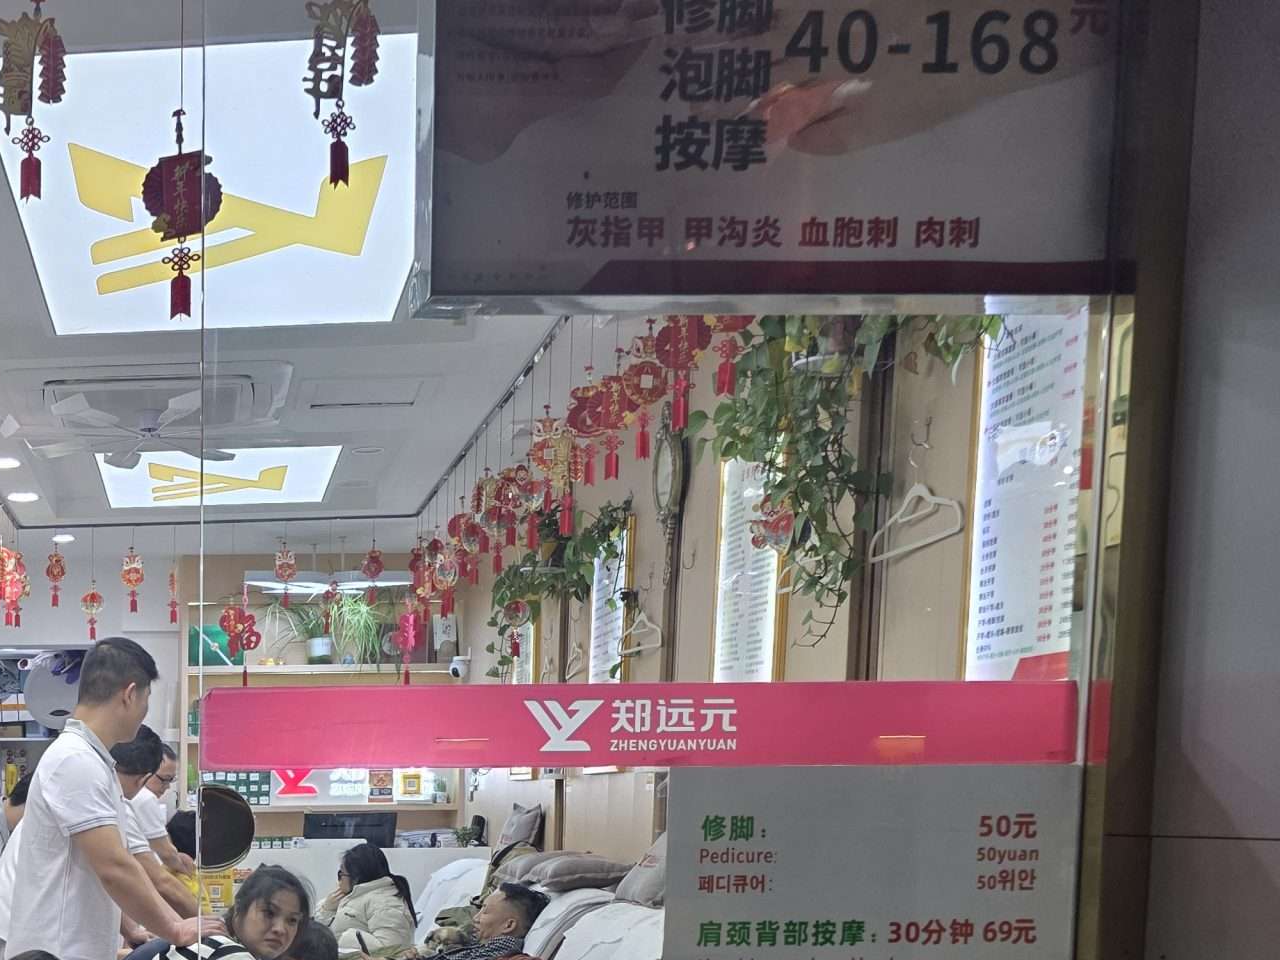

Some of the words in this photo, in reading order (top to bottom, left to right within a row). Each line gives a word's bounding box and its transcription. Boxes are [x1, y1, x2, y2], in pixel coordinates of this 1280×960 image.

[659, 0, 770, 34] 修脚
[658, 48, 771, 102] 泡脚
[655, 114, 768, 171] 按摩
[566, 191, 638, 209] 修护范围
[566, 216, 665, 248] 灰指甲
[685, 216, 783, 248] 甲沟炎
[915, 216, 981, 248] 肉刺
[610, 698, 737, 733] 郑远元
[609, 739, 737, 752] ZHENGYUANYUAN
[979, 814, 1038, 838] 50元
[699, 848, 777, 865] Pedicure:
[976, 847, 1039, 864] 50yuan
[976, 871, 1035, 891] 50위안
[982, 918, 1037, 944] 69元
